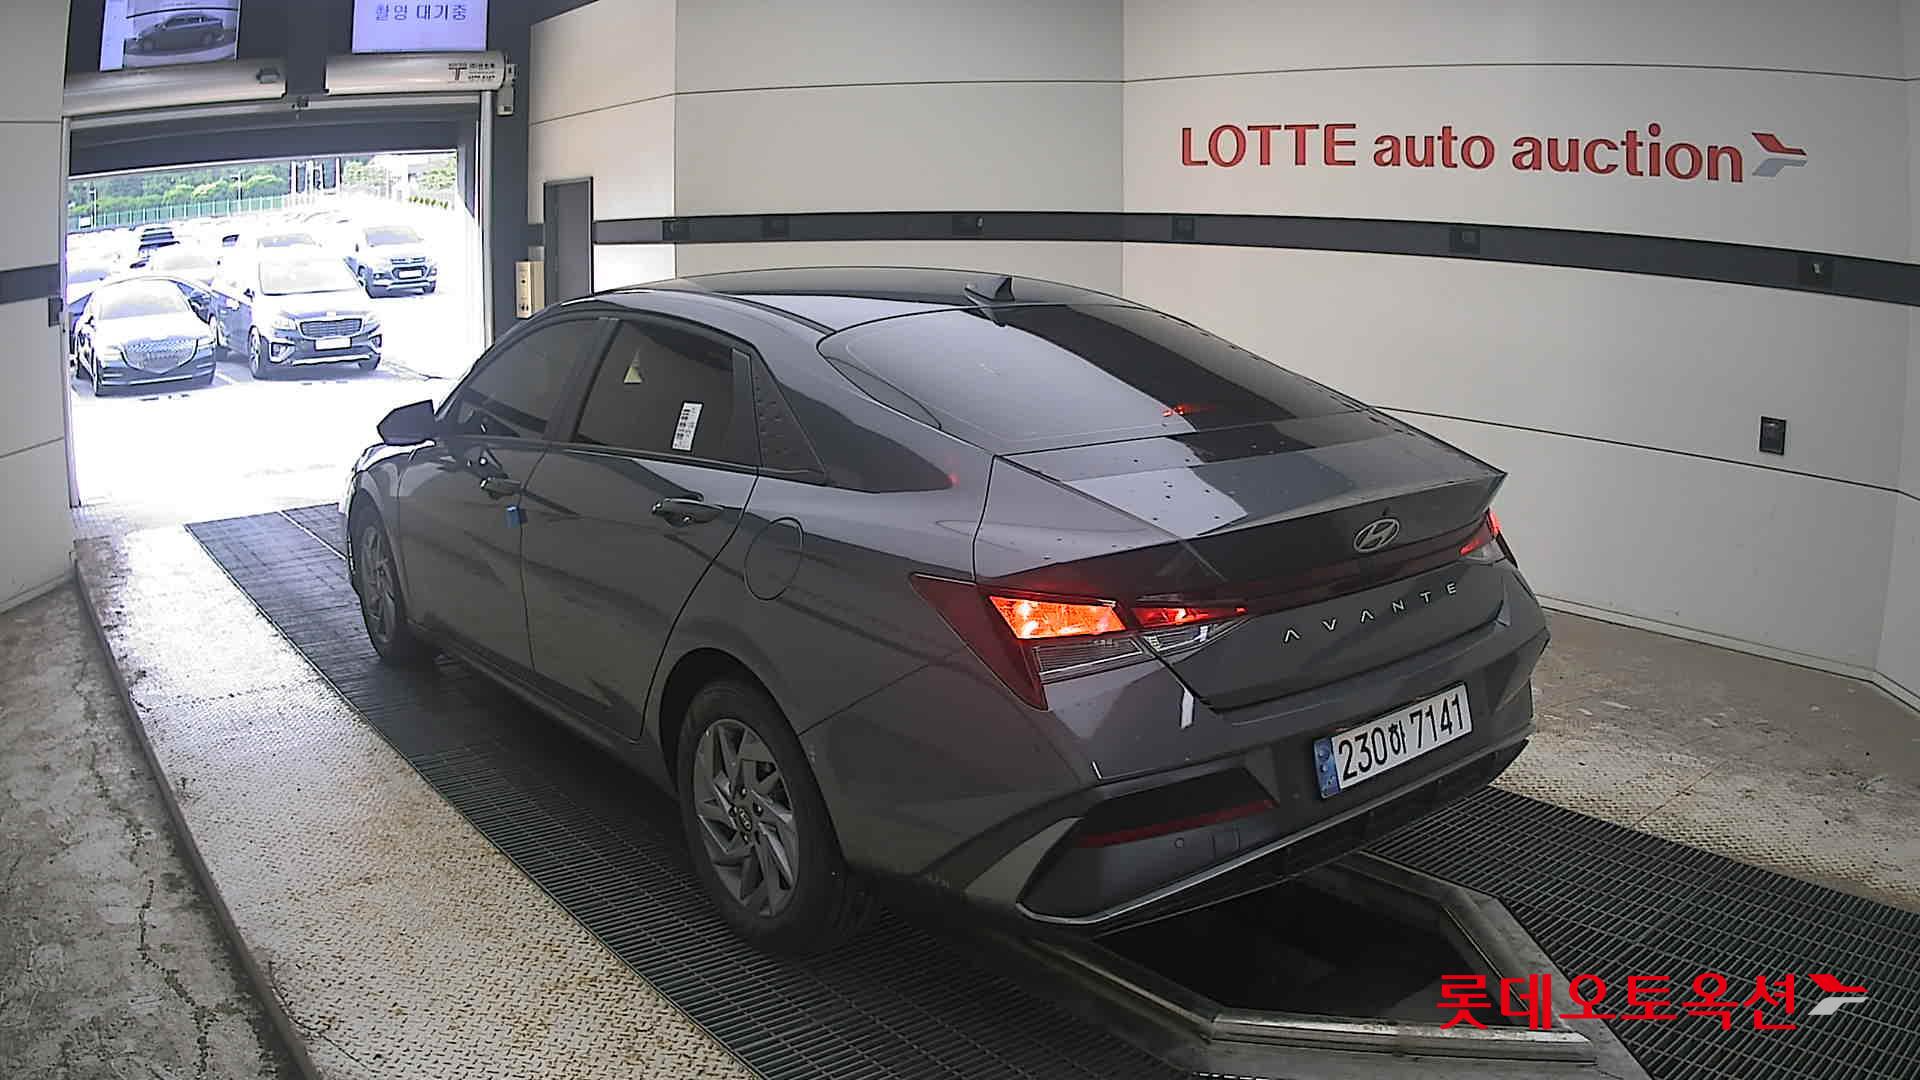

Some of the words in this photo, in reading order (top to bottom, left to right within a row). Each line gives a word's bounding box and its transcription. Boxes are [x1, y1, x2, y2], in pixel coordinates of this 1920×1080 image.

[1181, 123, 1357, 167] LOTTE
[1373, 125, 1496, 169] auto
[1511, 123, 1743, 182] auction
[1284, 583, 1458, 643] AVANTE
[1338, 720, 1407, 781] 230하
[1409, 693, 1464, 750] 7141
